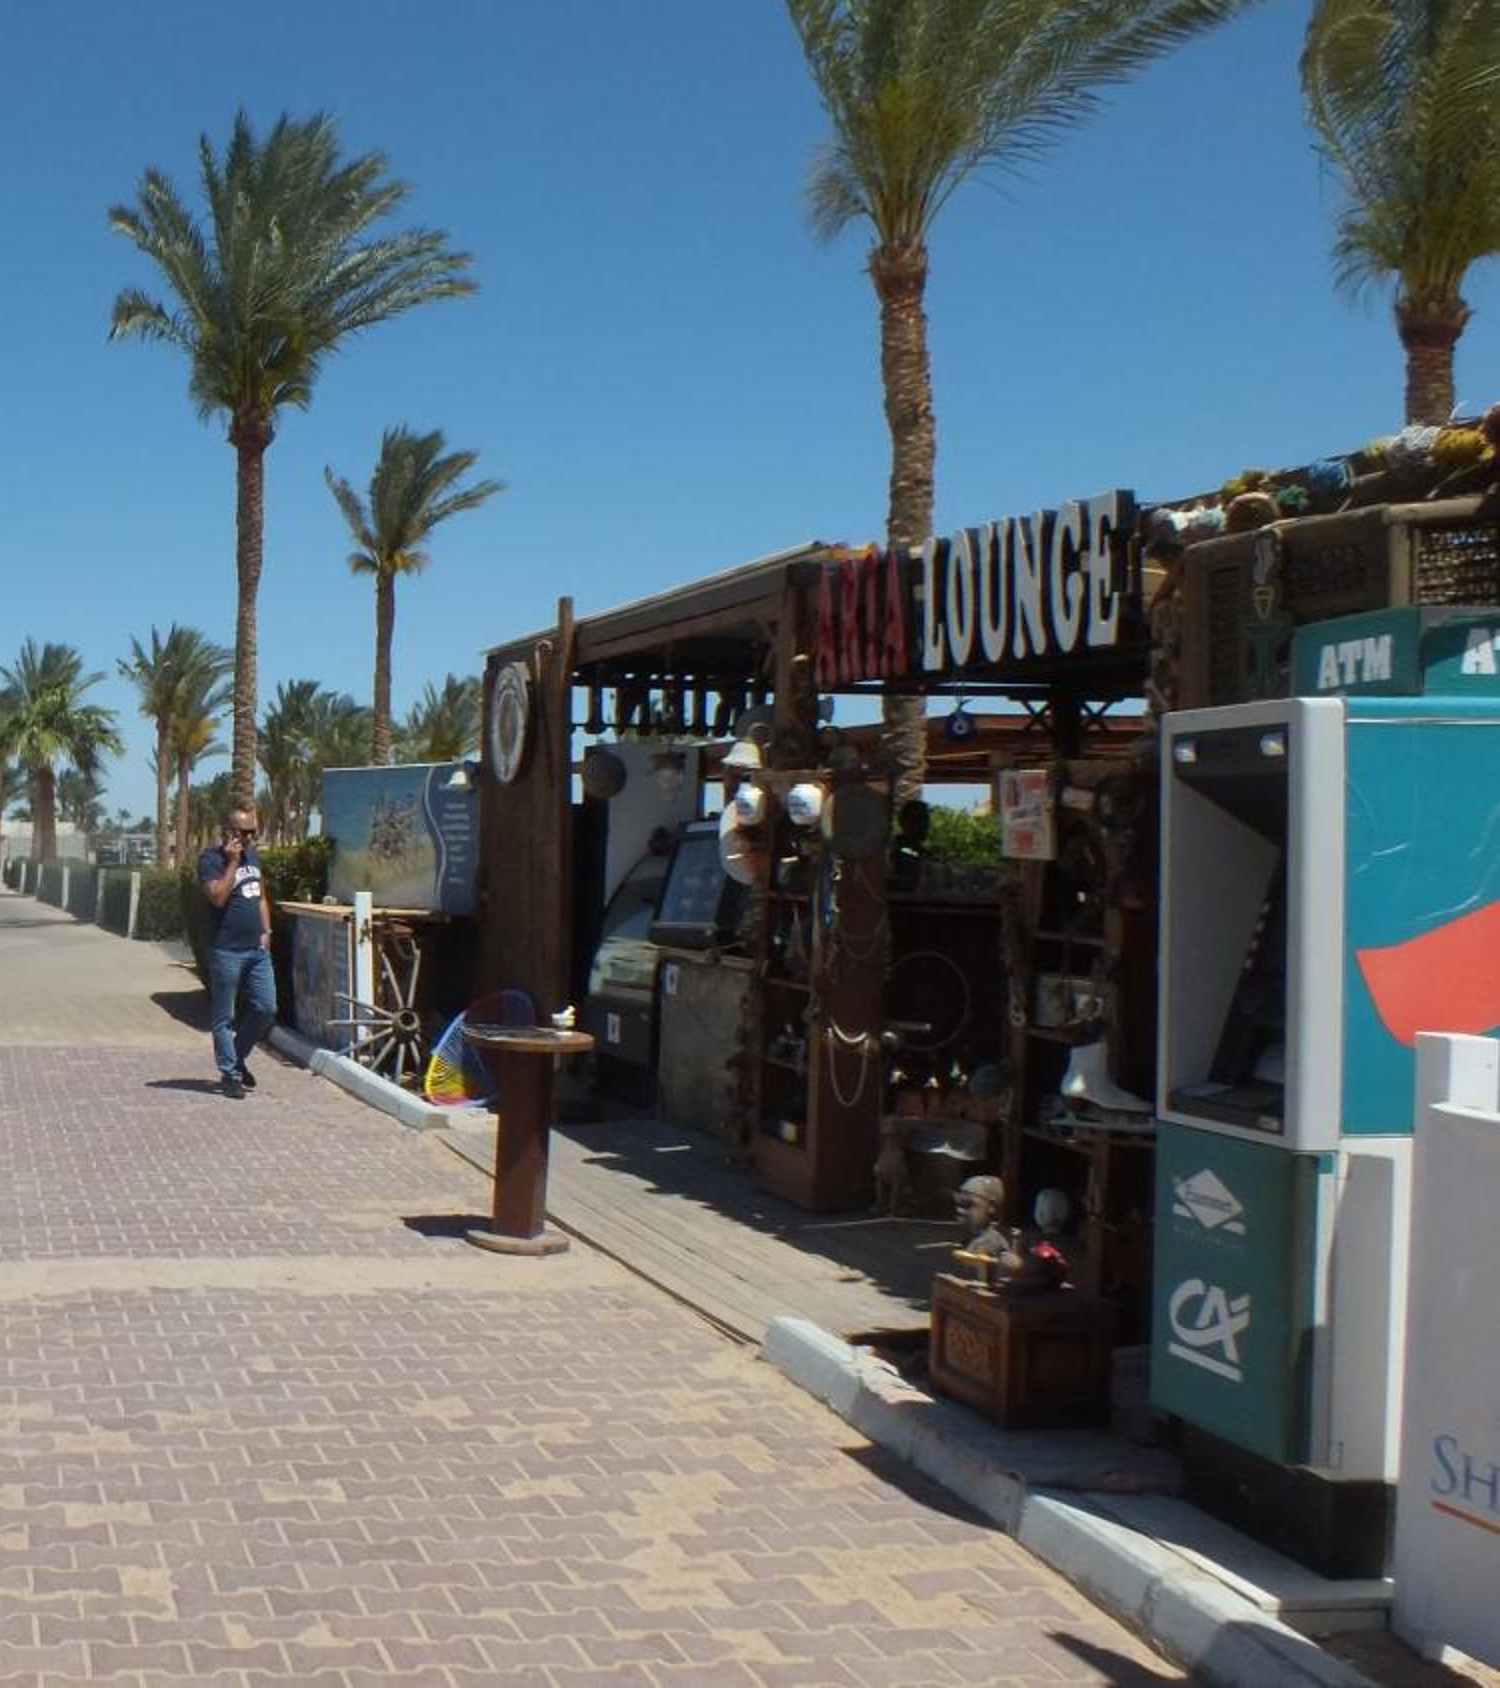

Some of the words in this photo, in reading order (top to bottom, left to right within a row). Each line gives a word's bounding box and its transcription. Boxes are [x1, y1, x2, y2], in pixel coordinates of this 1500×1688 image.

[921, 490, 1126, 671] LOUNGE
[1317, 634, 1393, 689] ATM
[1460, 628, 1500, 675] A
